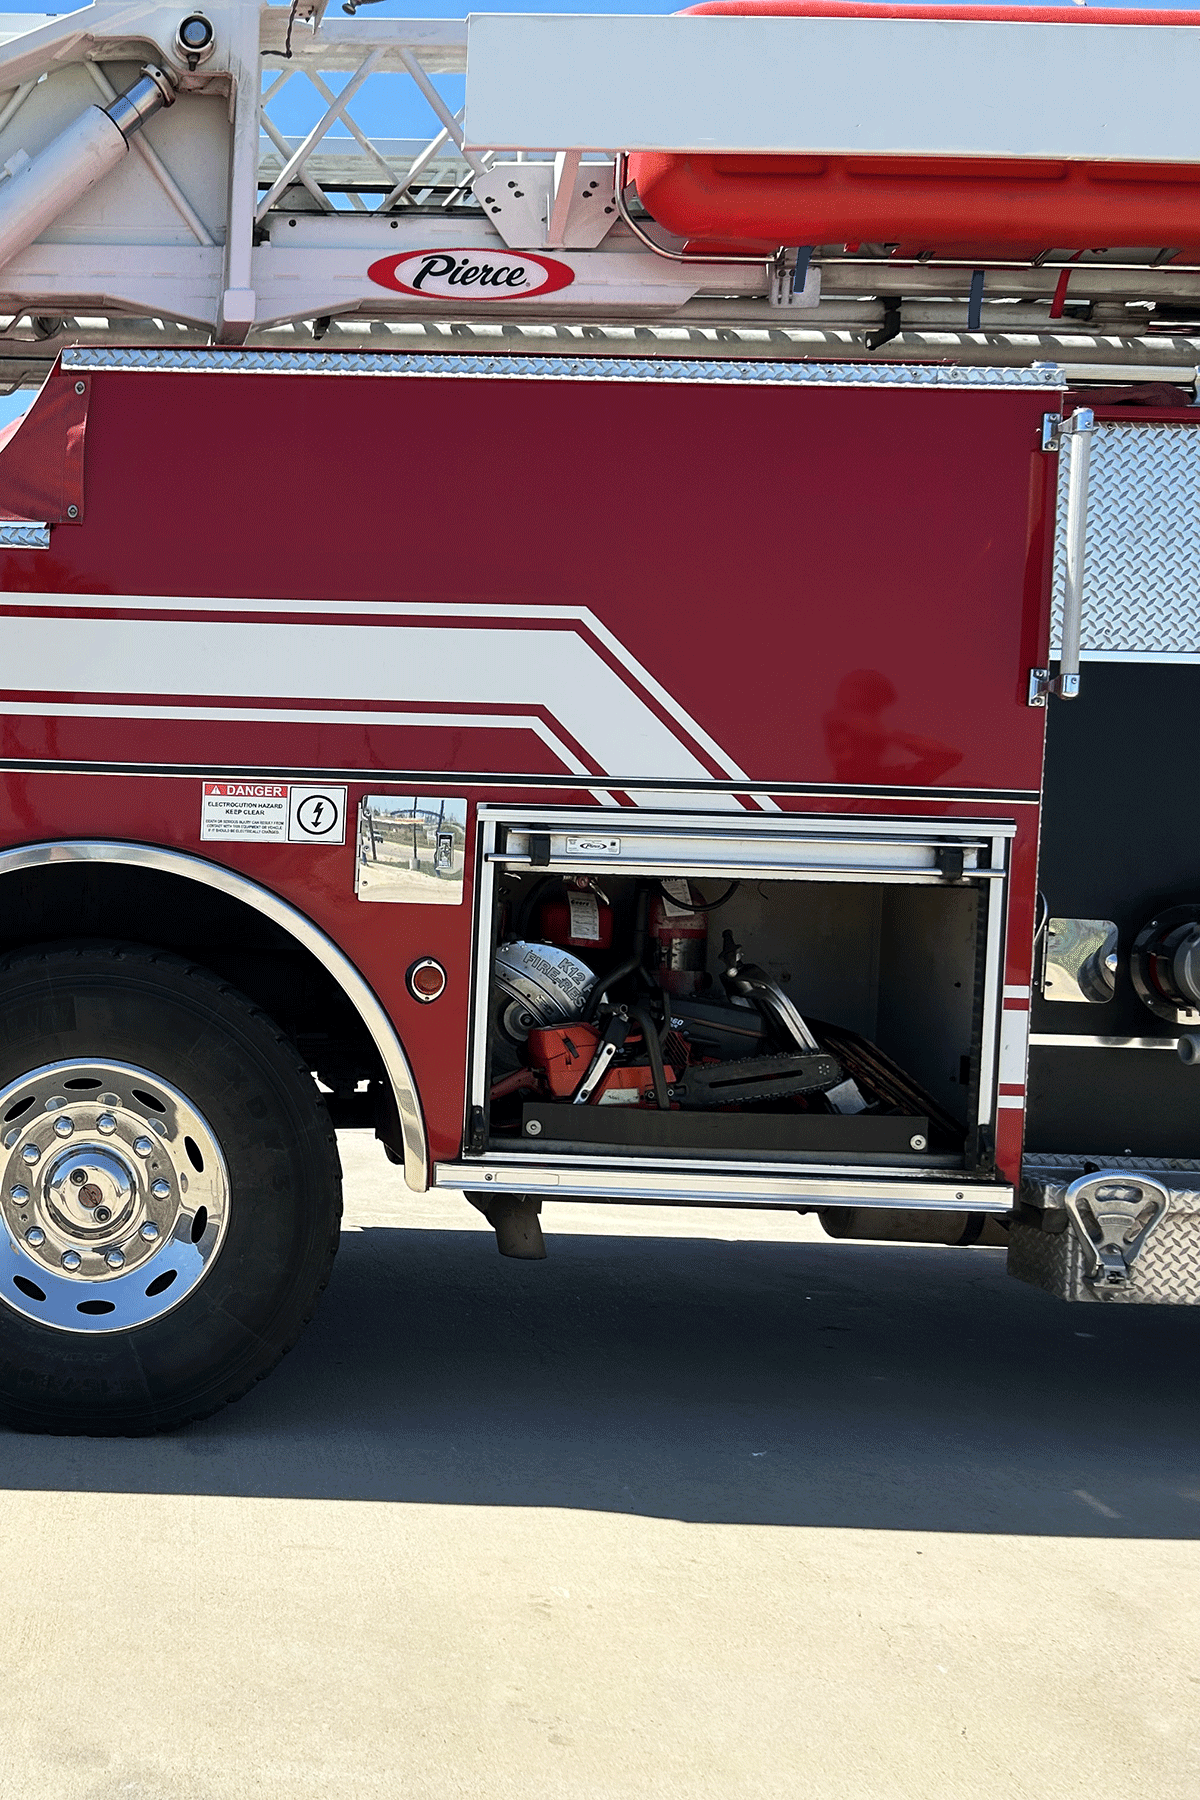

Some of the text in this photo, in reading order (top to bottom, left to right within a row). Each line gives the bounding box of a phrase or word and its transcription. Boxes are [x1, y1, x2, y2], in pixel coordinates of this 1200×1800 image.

[412, 254, 527, 289] Pierce
[226, 785, 282, 796] DANGER
[523, 951, 586, 1011] FIRE-RES
[558, 957, 586, 986] K12
